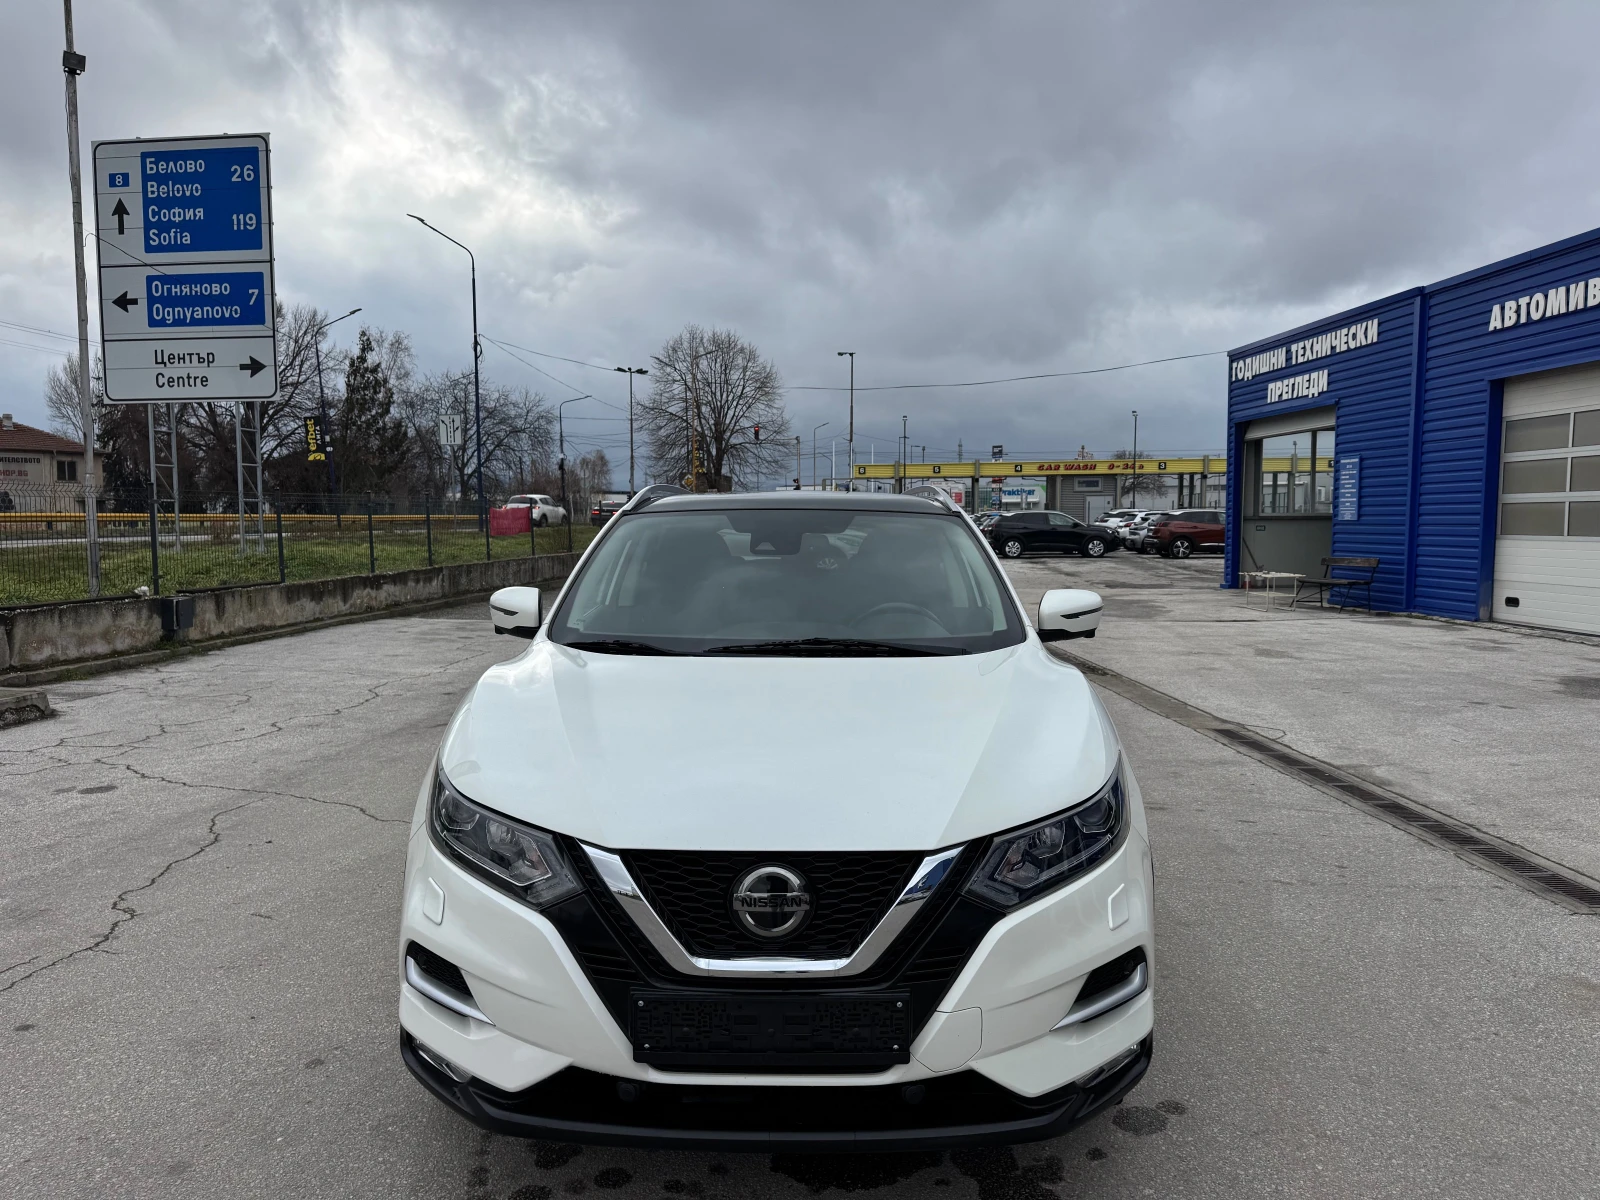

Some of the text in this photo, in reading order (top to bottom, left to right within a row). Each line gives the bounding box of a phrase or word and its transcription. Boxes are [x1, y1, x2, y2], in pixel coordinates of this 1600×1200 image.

[146, 157, 205, 175] Белово
[230, 164, 255, 182] 26
[115, 175, 123, 186] 8
[147, 181, 202, 198] Belovo
[148, 205, 204, 223] София
[232, 213, 257, 231] 119
[149, 229, 191, 246] Sofia
[151, 280, 231, 298] Огняново
[248, 289, 259, 306] 7
[1488, 277, 1600, 332] АВТОМИВ
[152, 303, 241, 325] Ognyanovo
[154, 349, 216, 368] Център
[1231, 318, 1379, 382] ГОДИШНИ ТЕХНИЧЕСКИ
[155, 372, 209, 388] Centre
[1267, 369, 1329, 404] ПРЕГЛЕДИ
[306, 418, 317, 451] efbet
[1064, 463, 1097, 471] WASH
[741, 897, 802, 908] NISSAN
